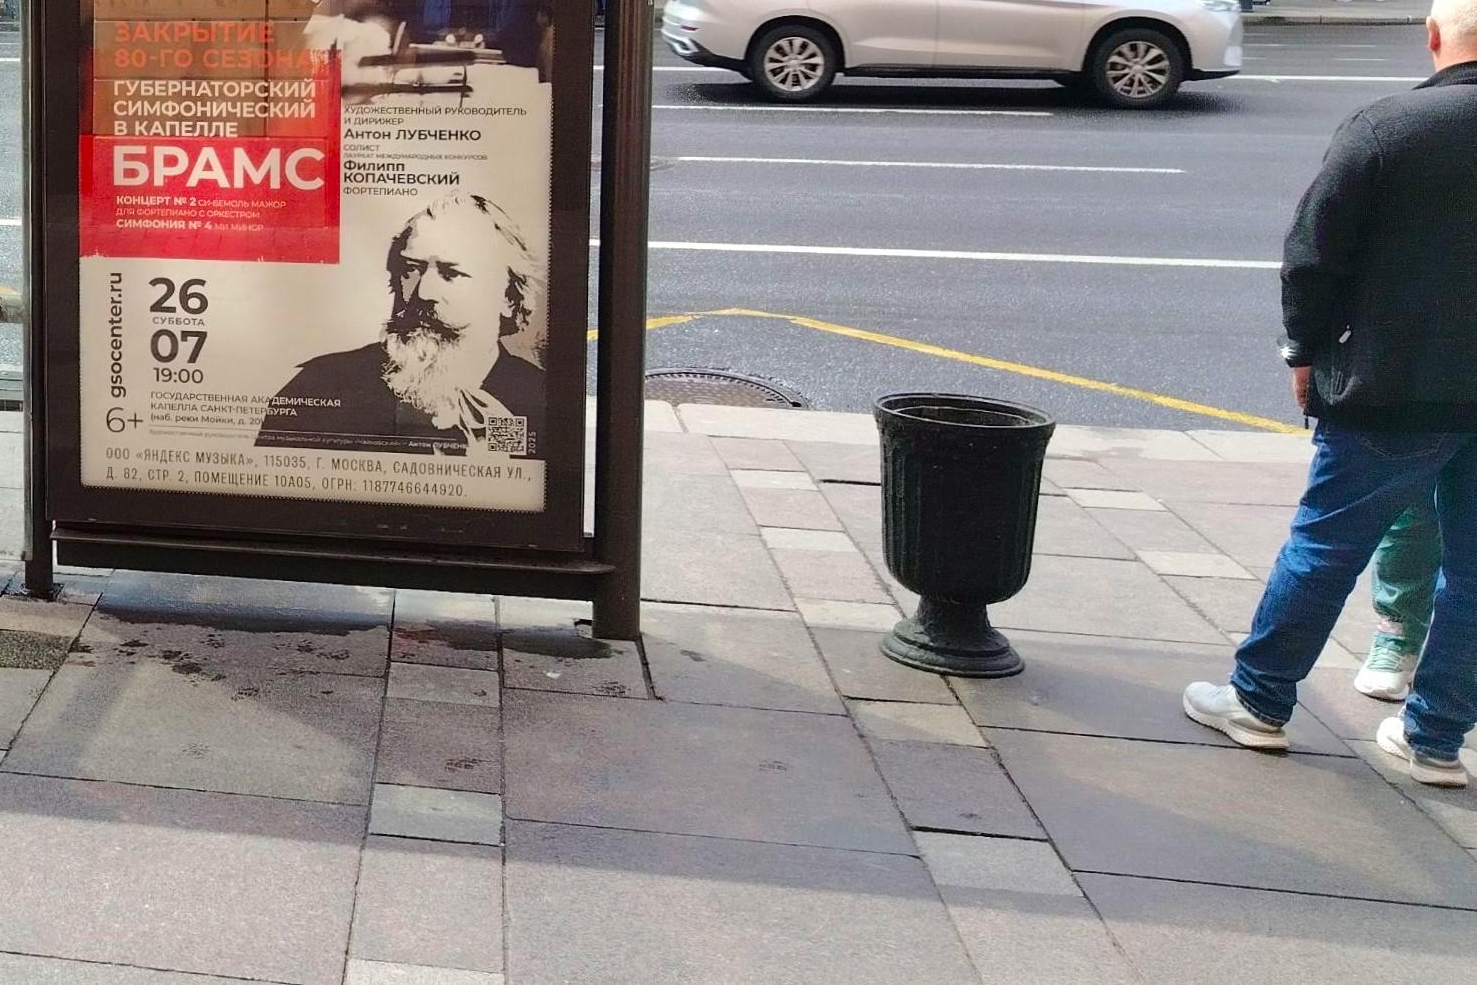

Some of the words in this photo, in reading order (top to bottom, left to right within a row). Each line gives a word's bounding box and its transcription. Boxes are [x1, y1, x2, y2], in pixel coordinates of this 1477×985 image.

[114, 21, 274, 43] ЗАКРЫТИЕ
[114, 48, 193, 69] 80-ГО
[202, 49, 310, 70] СЕЗОНА
[113, 78, 316, 98] ГУБЕРНАТОРСКИЙ
[113, 99, 316, 119] СИМФОНИЧЕСКИЙ
[344, 105, 442, 116] ХУДОЖЕСТВЕННЫЙ
[445, 107, 527, 117] РУКОВОДИТЕЛЬ
[114, 121, 127, 136] В
[135, 121, 238, 138] КАПЕЛЛЕ
[354, 118, 404, 126] ДИРИЖЕР
[344, 128, 391, 140] Антон
[395, 129, 482, 141] ЛУБЧЕНКО
[113, 145, 325, 190] БРАМС
[343, 160, 405, 172] Филипп
[344, 172, 460, 185] КОПАЧЕВСКИЙ
[343, 187, 418, 196] ФОРТЕПИАНО
[116, 195, 171, 206] КОНЦЕРТ
[189, 197, 197, 206] 2
[198, 199, 249, 208] СИ-БЕМОЛЬ
[251, 200, 287, 209] МАЖОР
[116, 208, 135, 217] ДЛЯ
[137, 208, 197, 217] ФОРТЕПИАНО
[207, 210, 260, 218] ОРКЕСТРОМ
[116, 219, 185, 230] СИМФОНИЯ
[204, 221, 212, 230] 4
[215, 223, 229, 231] МИ
[231, 224, 264, 232] МИНОР
[149, 277, 209, 315] 26
[152, 316, 206, 326] СУББОТА
[108, 273, 127, 399] gsocenter.ru
[150, 329, 208, 363] 07
[153, 367, 204, 384] 19:00
[150, 391, 248, 404] ГОСУДАРСТВЕННАЯ
[250, 395, 341, 408] АКАДЕМИЧЕСКАЯ
[150, 402, 198, 412] КАПЕЛЛА
[200, 404, 298, 417] САНКТ-ПЕТЕРБУРГА
[106, 407, 143, 433] 6+
[151, 413, 172, 423] (наб.
[175, 415, 199, 424] реки
[201, 415, 235, 425] Мойки,
[528, 431, 537, 454] 2025
[106, 447, 130, 460] ООО
[136, 448, 190, 464] «ЯНДЕКС
[196, 450, 258, 468] МУЗЫКА»,
[264, 455, 311, 471] 115035,
[331, 457, 387, 474] МОСКВА,
[393, 461, 501, 478] САДОВНИЧЕСКАЯ
[507, 467, 531, 482] УЛ.,
[124, 468, 142, 481] 82,
[147, 469, 171, 481] СТР.
[178, 470, 189, 484] 2,
[194, 471, 269, 488] ПОМЕЩЕНИЕ
[322, 477, 356, 491] ОГРН:
[363, 479, 467, 498] 1187746644920.
